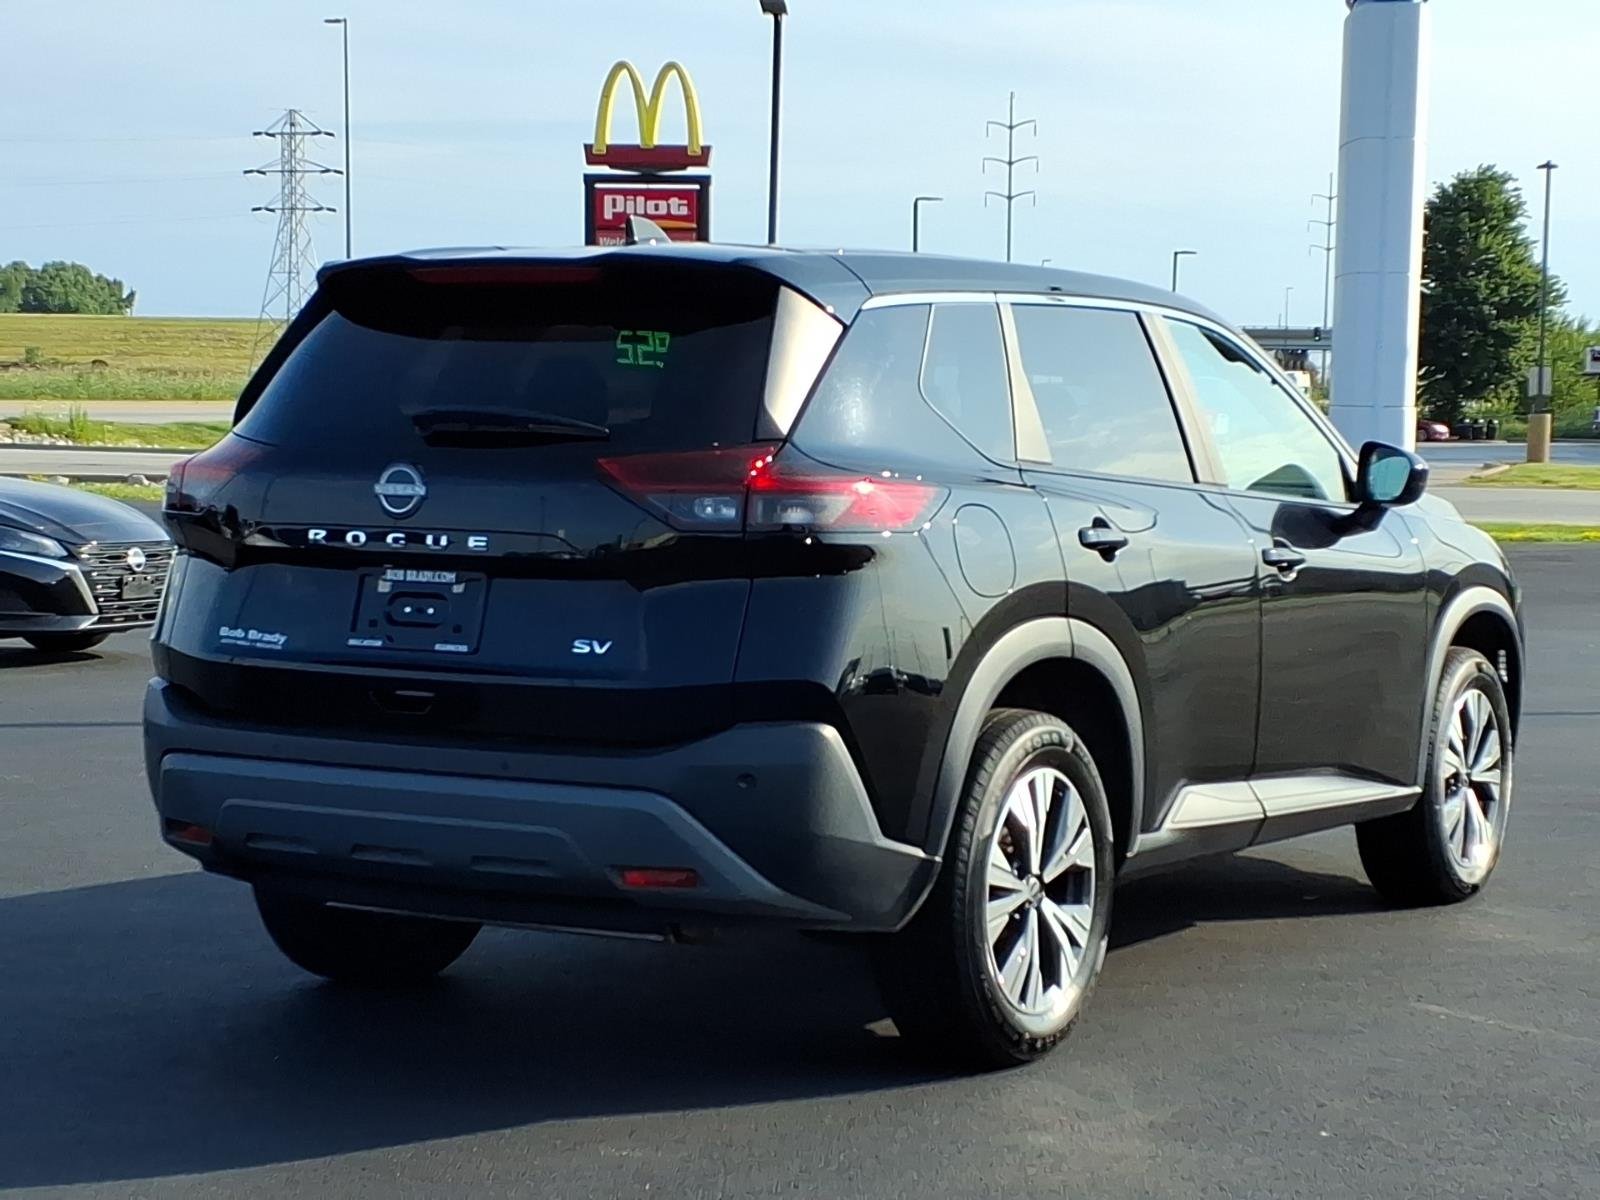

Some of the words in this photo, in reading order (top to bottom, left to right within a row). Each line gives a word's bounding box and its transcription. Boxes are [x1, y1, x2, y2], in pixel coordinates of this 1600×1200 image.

[604, 194, 689, 219] Pilot
[307, 528, 489, 551] ROGUE
[219, 626, 246, 639] Bob
[247, 629, 288, 645] Brady
[571, 639, 613, 655] SV
